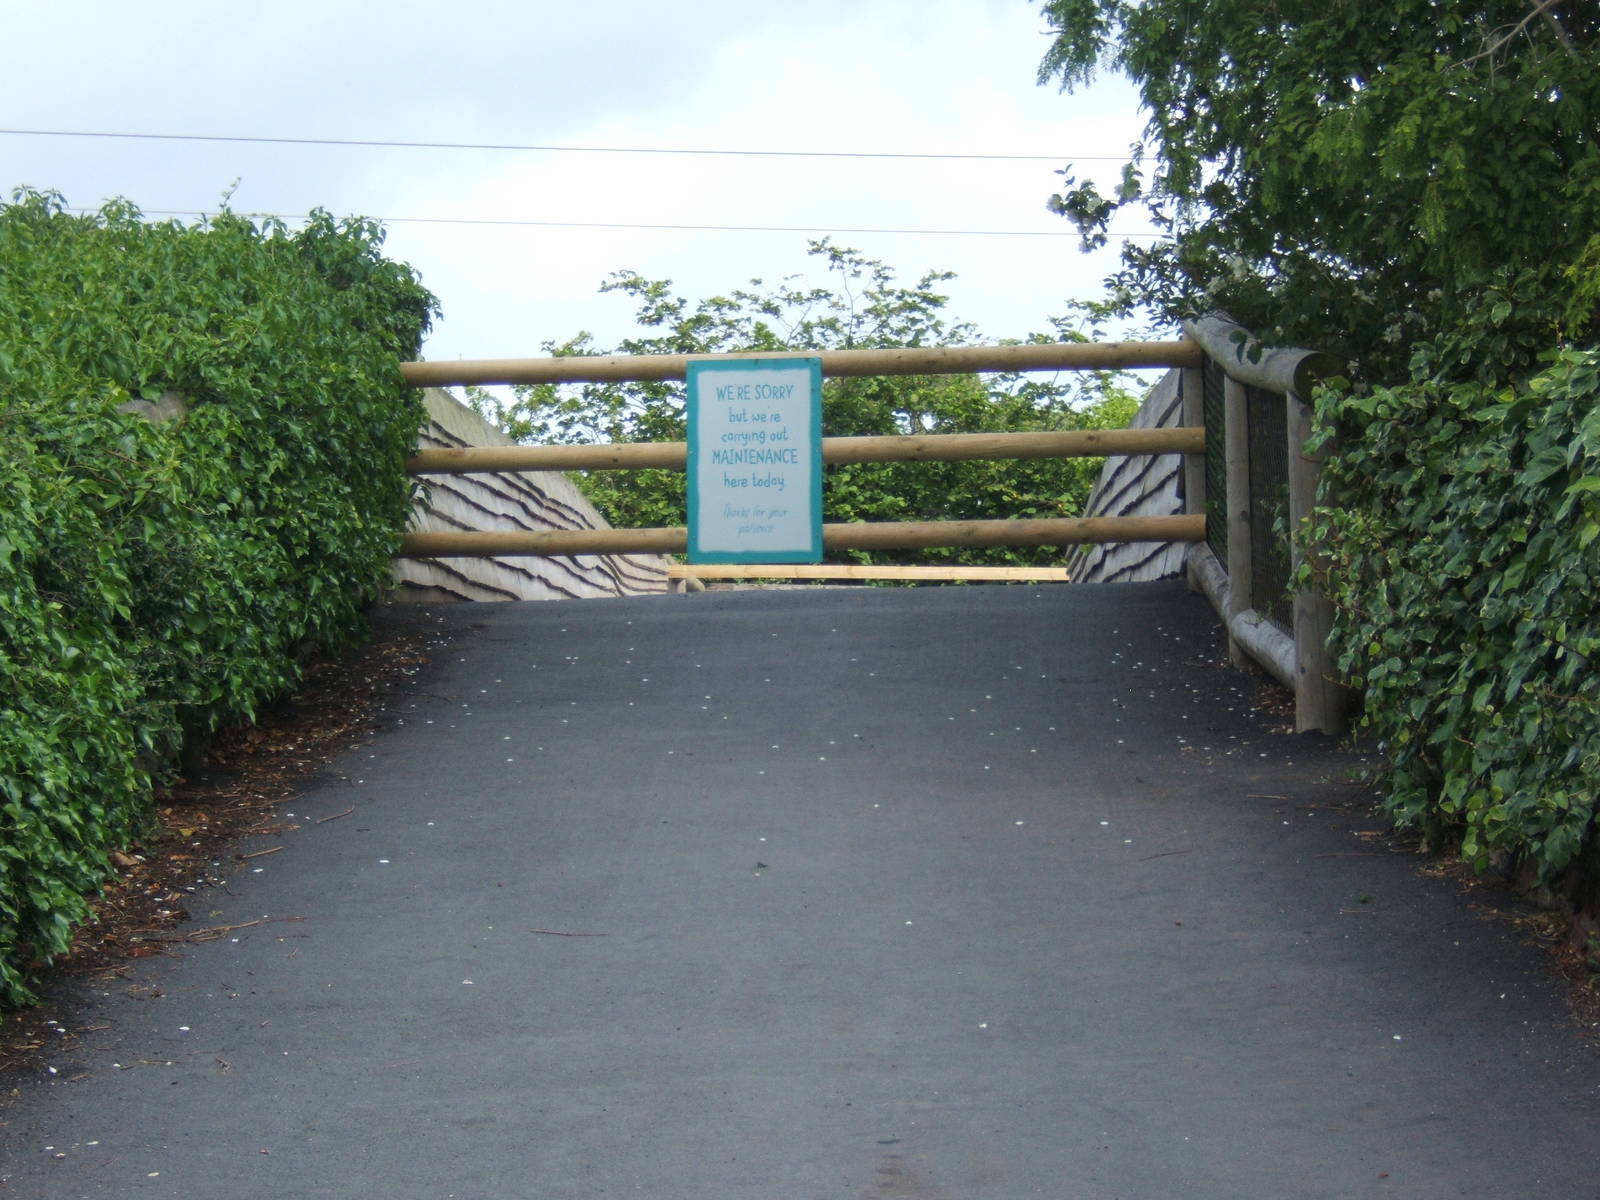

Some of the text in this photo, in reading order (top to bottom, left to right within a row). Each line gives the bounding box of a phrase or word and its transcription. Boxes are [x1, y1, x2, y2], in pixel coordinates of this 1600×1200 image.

[754, 384, 794, 400] SORRY
[728, 407, 748, 422] but
[721, 426, 788, 446] carrying out
[712, 448, 798, 465] MAINTENANCE
[723, 472, 785, 491] here today
